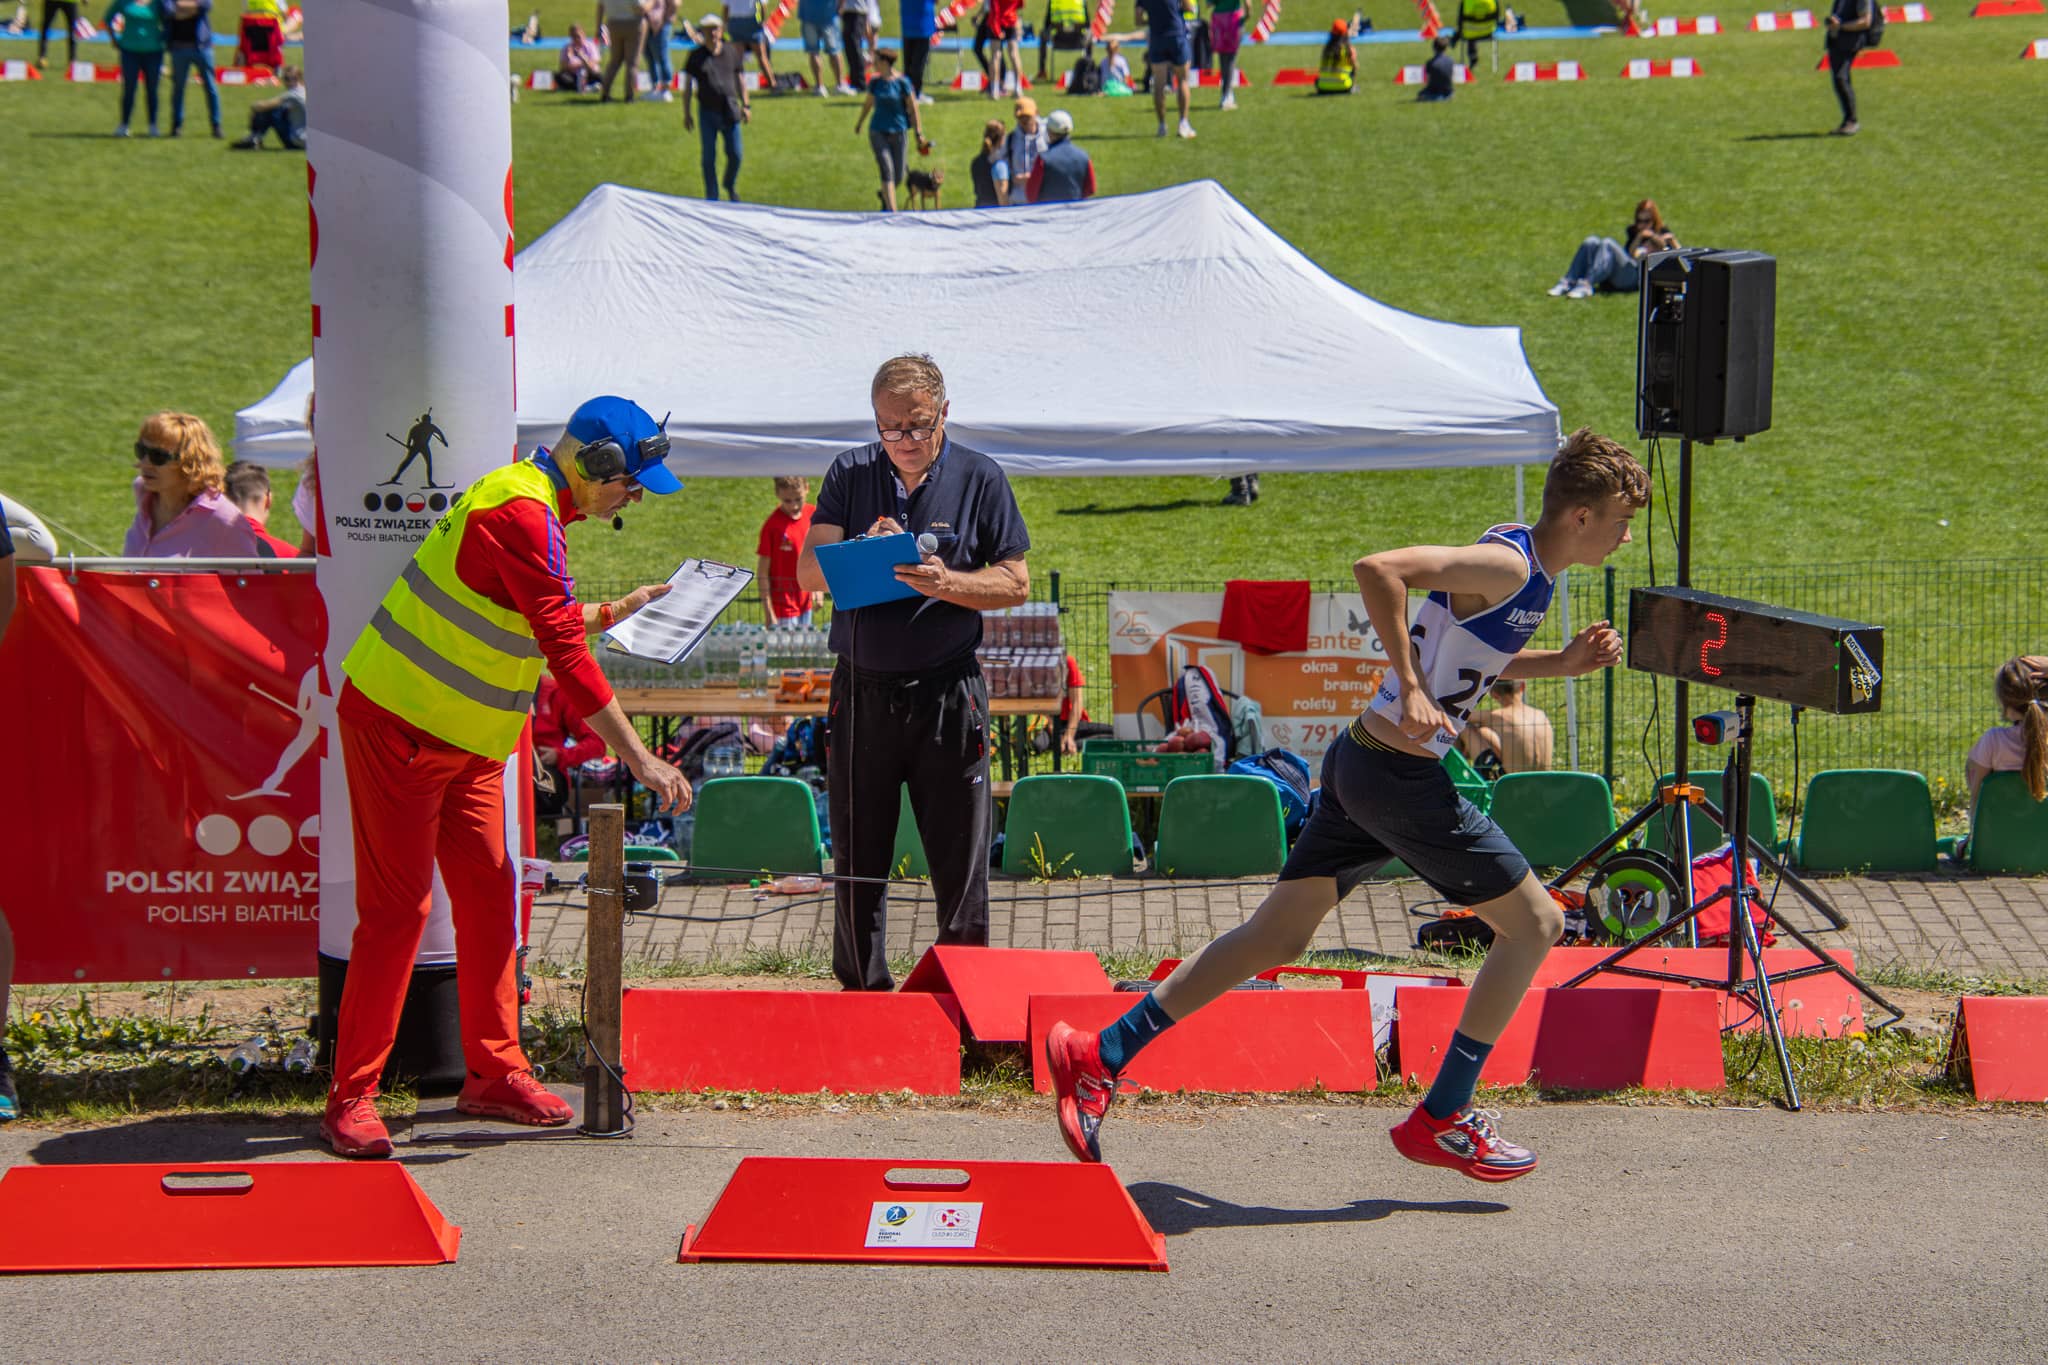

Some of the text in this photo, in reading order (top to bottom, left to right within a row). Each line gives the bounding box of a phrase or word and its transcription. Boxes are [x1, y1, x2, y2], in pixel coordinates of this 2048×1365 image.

[335, 516, 371, 529] POLSKI
[375, 518, 431, 532] ZWIĄZEK
[347, 532, 425, 543] POLISH BIATHLON
[1113, 610, 1151, 646] 25
[1700, 611, 1727, 676] 2
[1302, 661, 1339, 674] okna
[1323, 679, 1373, 694] bramy
[1293, 698, 1337, 712] rolety
[1301, 724, 1339, 744] 791
[106, 871, 213, 893] POLSKI
[148, 905, 226, 923] POLISH
